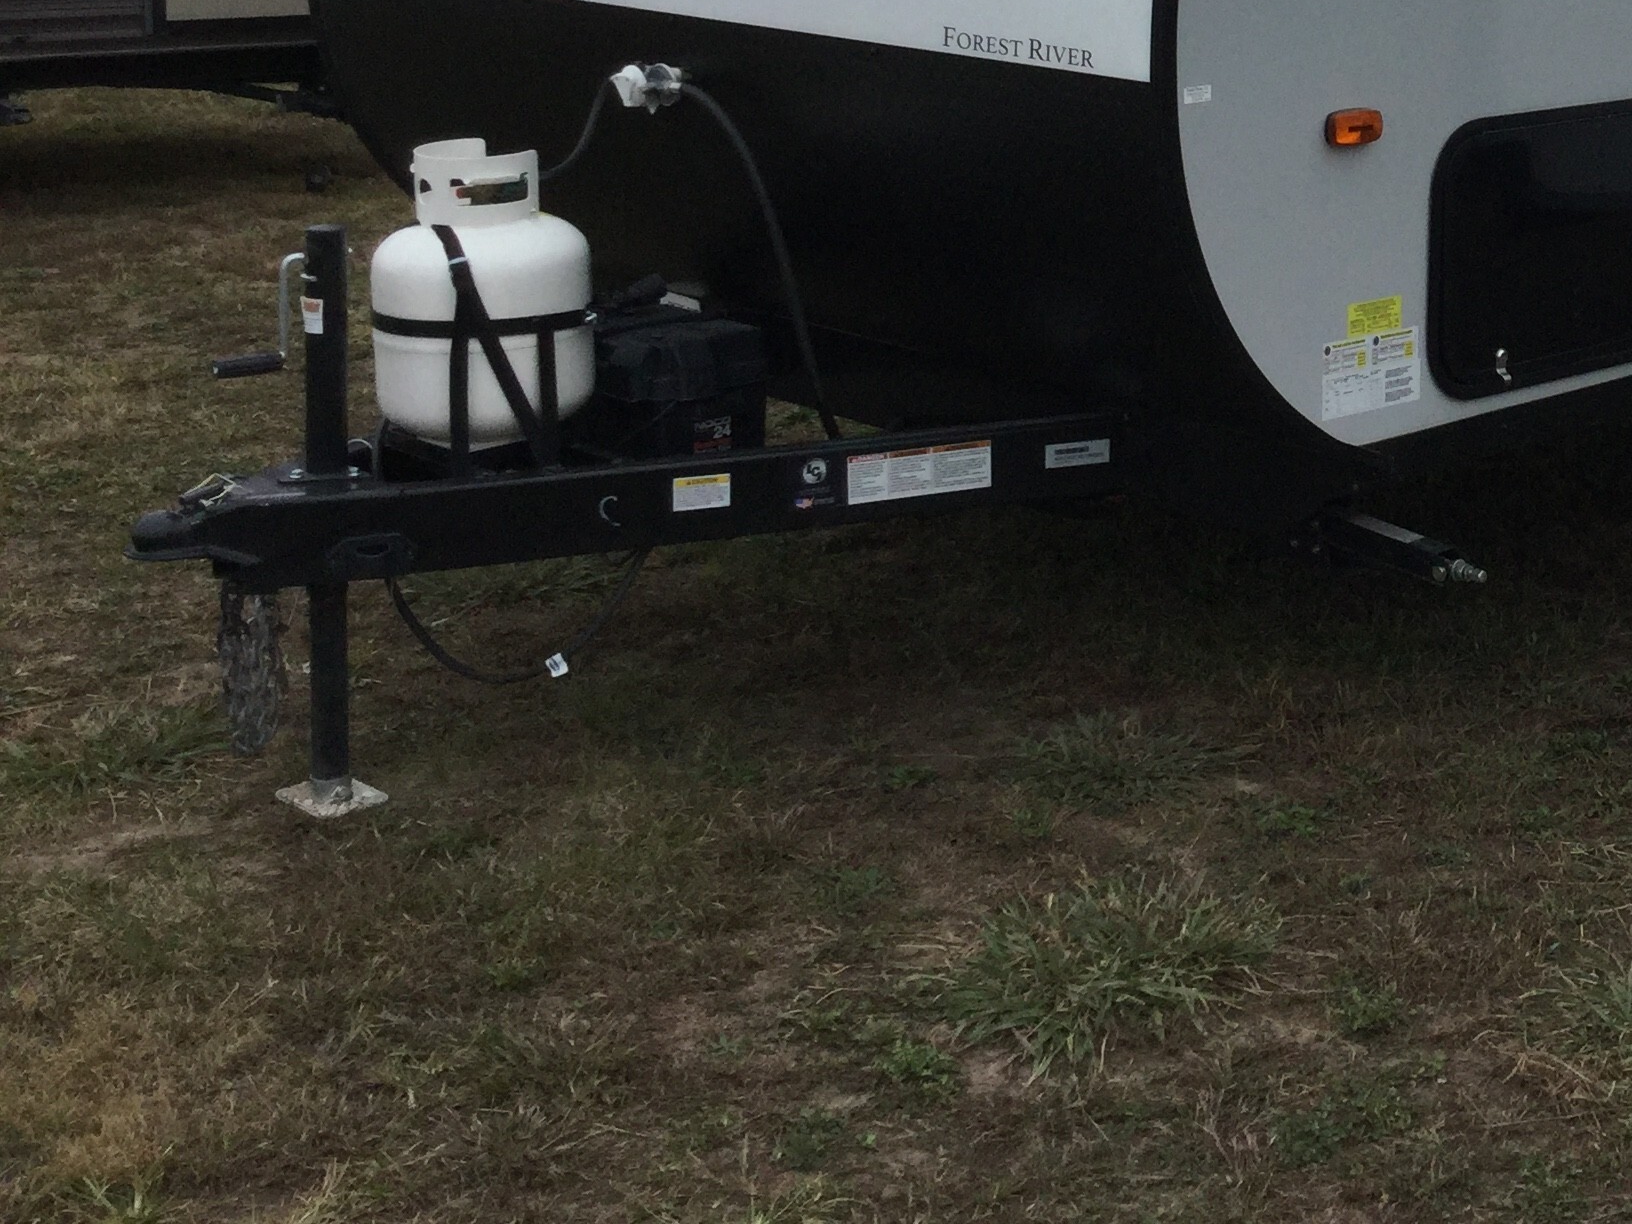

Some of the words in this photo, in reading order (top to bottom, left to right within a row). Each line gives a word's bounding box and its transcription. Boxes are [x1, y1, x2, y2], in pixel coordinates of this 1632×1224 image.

[942, 25, 1024, 58] FOREST
[1028, 38, 1095, 69] RIVER
[713, 424, 733, 439] 24
